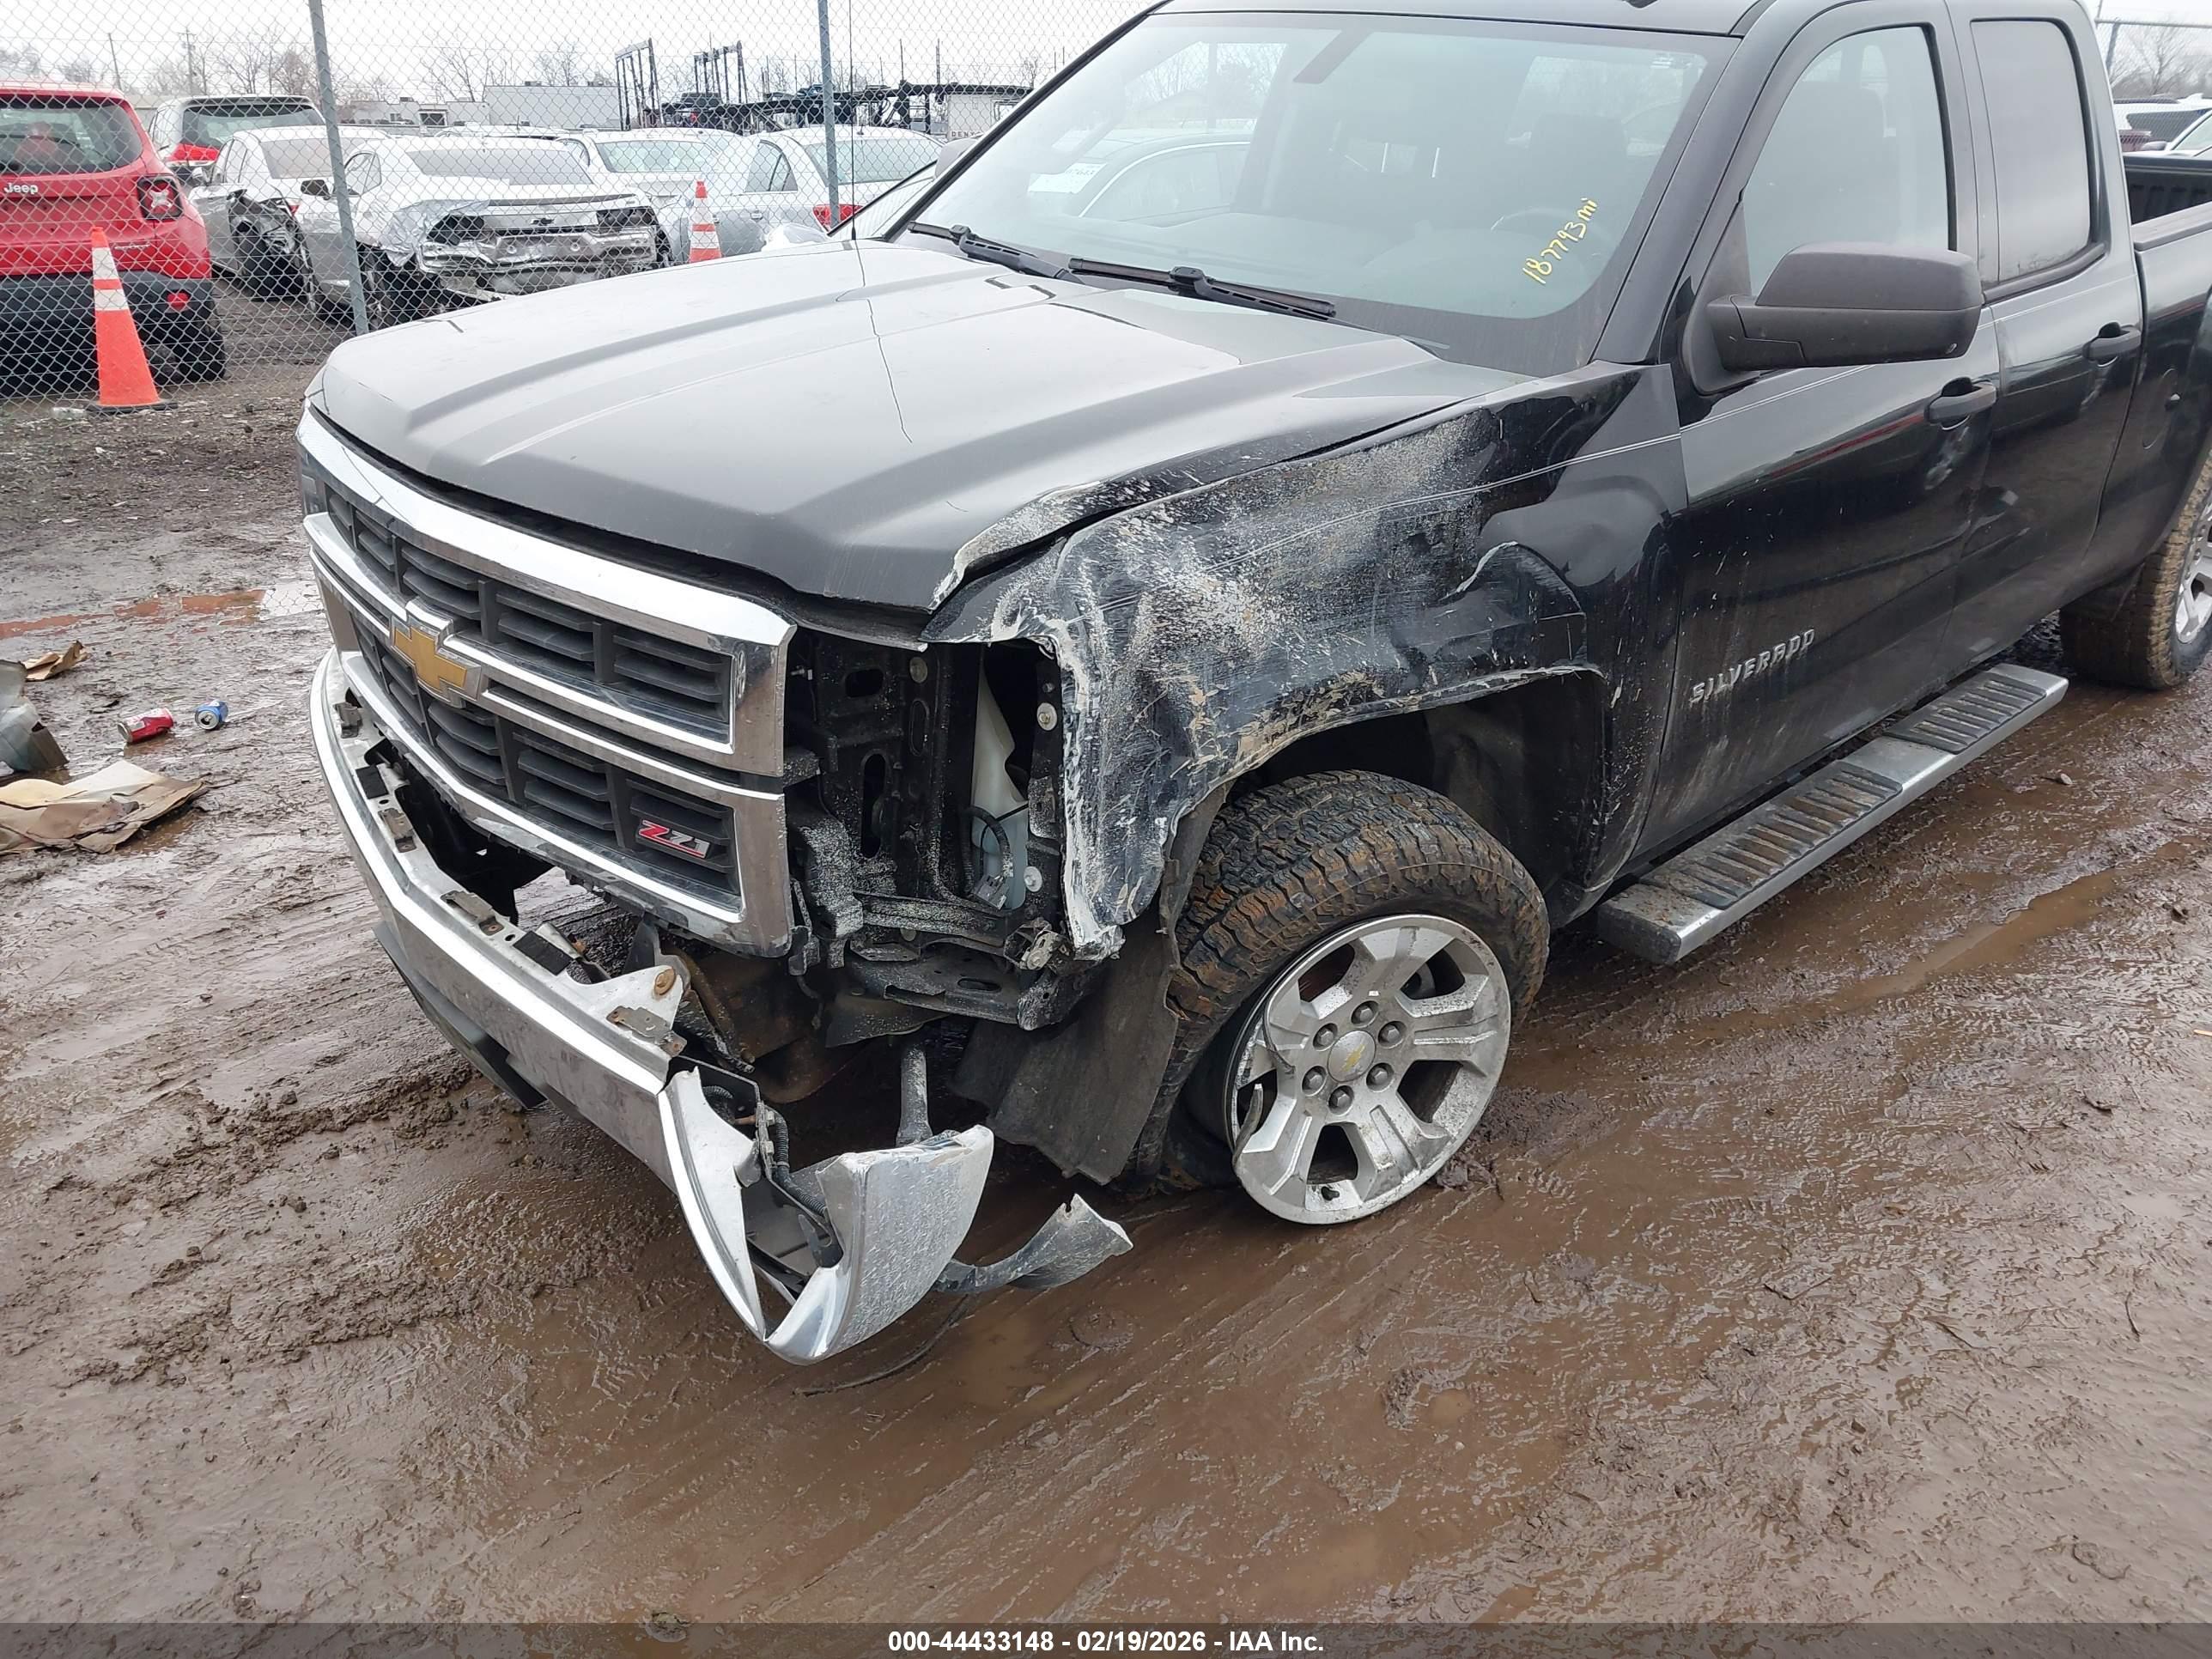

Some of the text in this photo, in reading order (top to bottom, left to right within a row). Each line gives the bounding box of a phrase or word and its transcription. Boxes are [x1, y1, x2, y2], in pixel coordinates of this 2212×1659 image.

[3, 183, 39, 195] Jeep
[1689, 628, 1815, 703] SILVERADO
[639, 819, 711, 859] Z71
